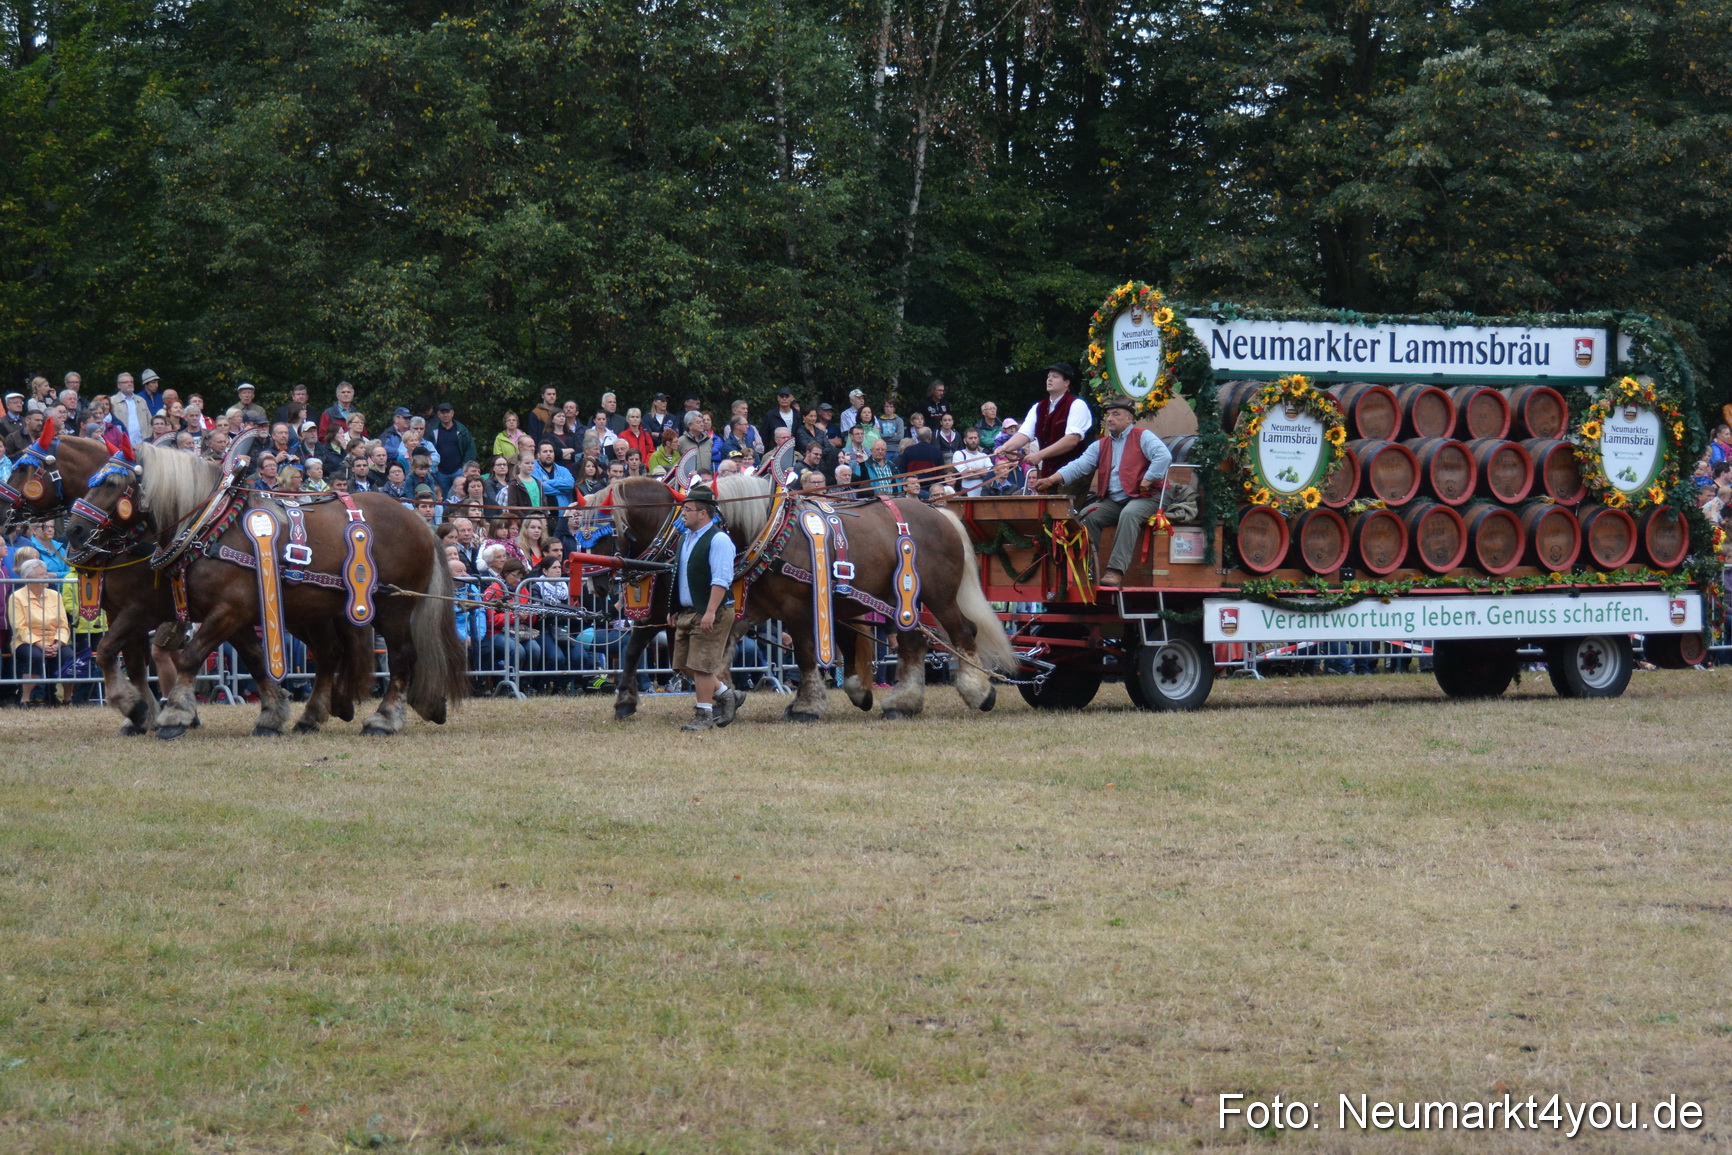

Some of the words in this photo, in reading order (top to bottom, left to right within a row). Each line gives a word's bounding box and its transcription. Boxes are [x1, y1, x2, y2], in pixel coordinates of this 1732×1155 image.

[1122, 329, 1153, 338] Neumarkter
[1117, 338, 1158, 351] Lammsbräu
[1211, 329, 1380, 362] Neumarkter
[1389, 331, 1550, 366] Lammsbräu
[1271, 424, 1311, 433] Neumarkter
[1612, 426, 1648, 434] Neumarkter
[1263, 432, 1317, 444] Lammsbräu
[1604, 434, 1654, 445] Lammsbräu
[1262, 609, 1416, 633] Verantwortung
[1422, 605, 1483, 627] leben.
[1488, 605, 1557, 625] Genuss
[1564, 601, 1649, 624] schaffen.
